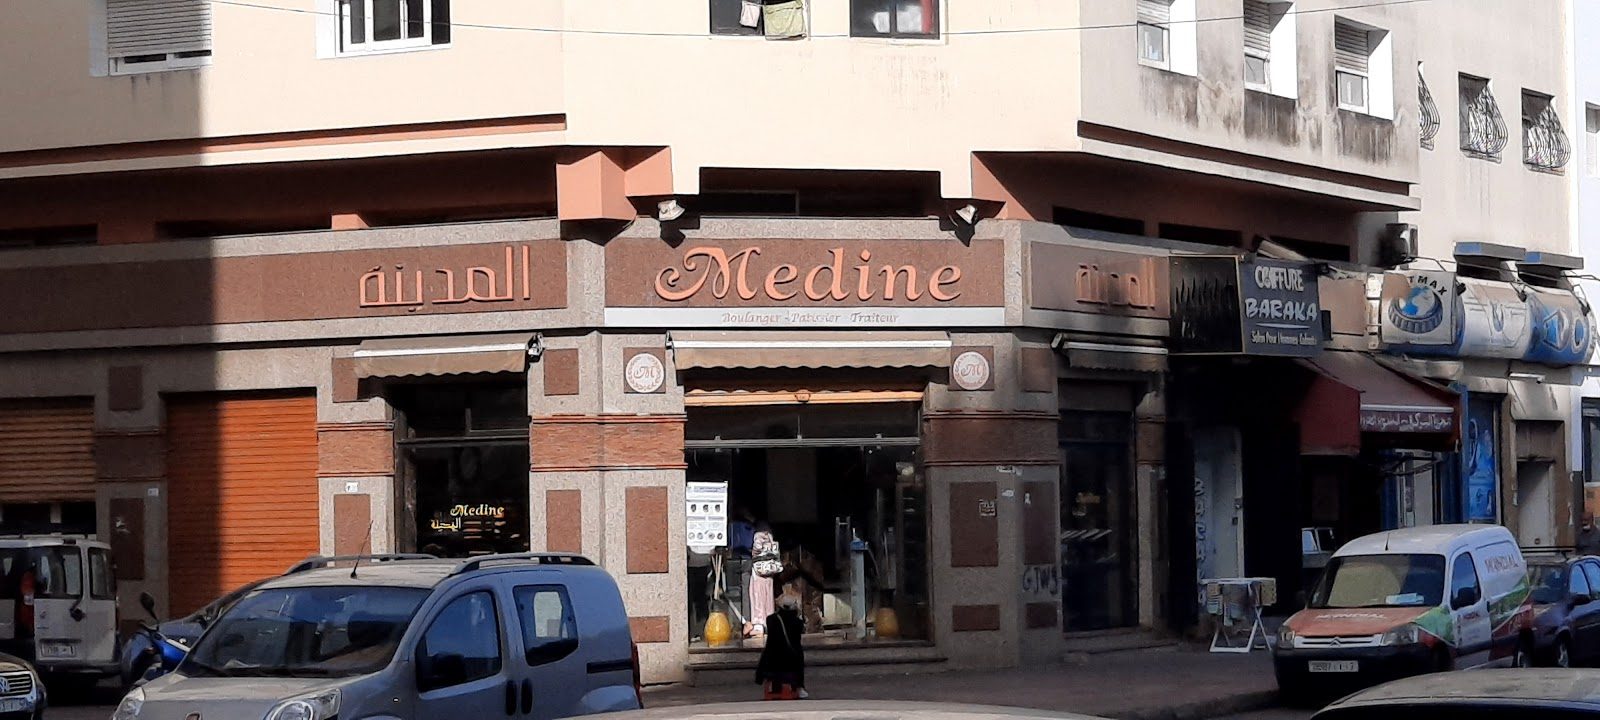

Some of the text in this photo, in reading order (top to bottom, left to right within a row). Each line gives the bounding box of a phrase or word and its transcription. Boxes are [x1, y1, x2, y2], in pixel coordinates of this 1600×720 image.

[359, 245, 531, 313] المدينة
[654, 246, 962, 302] Medine
[1254, 265, 1304, 292] COIFFURE
[721, 311, 781, 326] Boulanger
[850, 311, 900, 323] Traiteur
[1245, 298, 1318, 322] BARAKA
[450, 503, 505, 517] Medine
